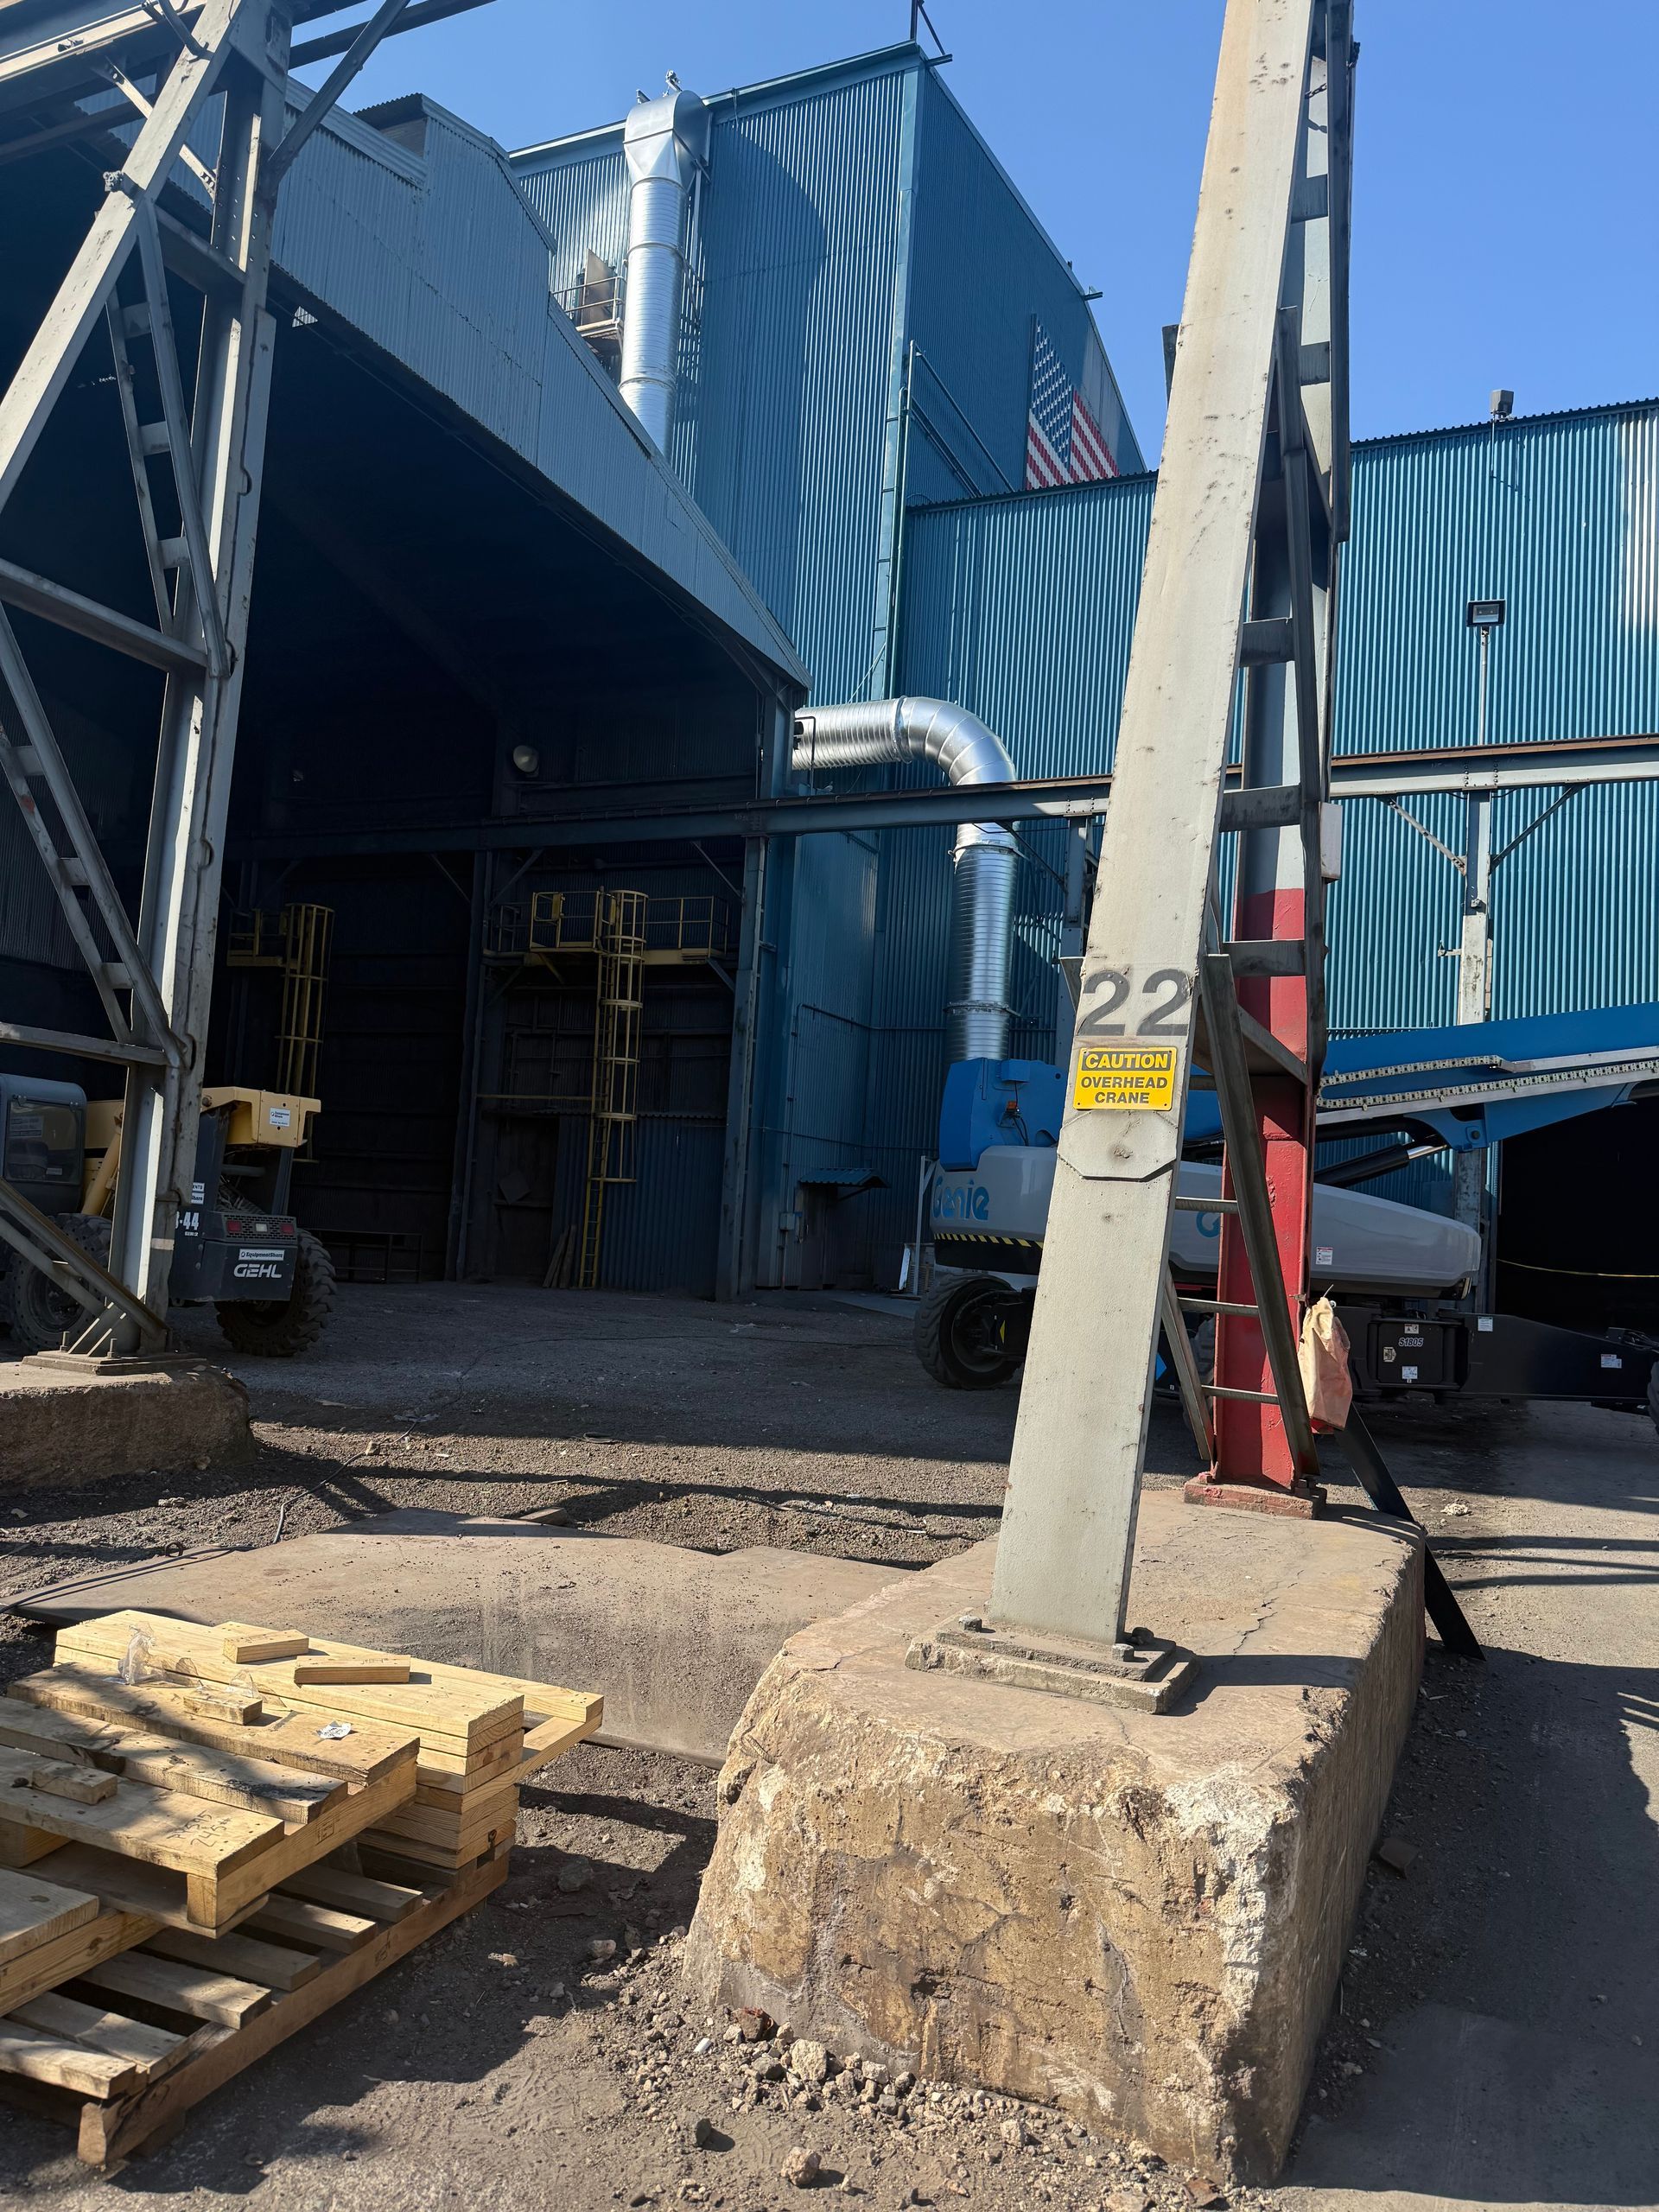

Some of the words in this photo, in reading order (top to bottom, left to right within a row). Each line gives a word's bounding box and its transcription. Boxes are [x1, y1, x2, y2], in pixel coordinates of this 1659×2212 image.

[1077, 969, 1192, 1036] 22
[1085, 1053, 1168, 1069] CAUTION
[1081, 1077, 1168, 1089] OVERHEAD
[1095, 1091, 1150, 1104] CRANE
[932, 1176, 989, 1221] Genie
[234, 1264, 283, 1278] GEHL
[1398, 1337, 1425, 1347] S1805
